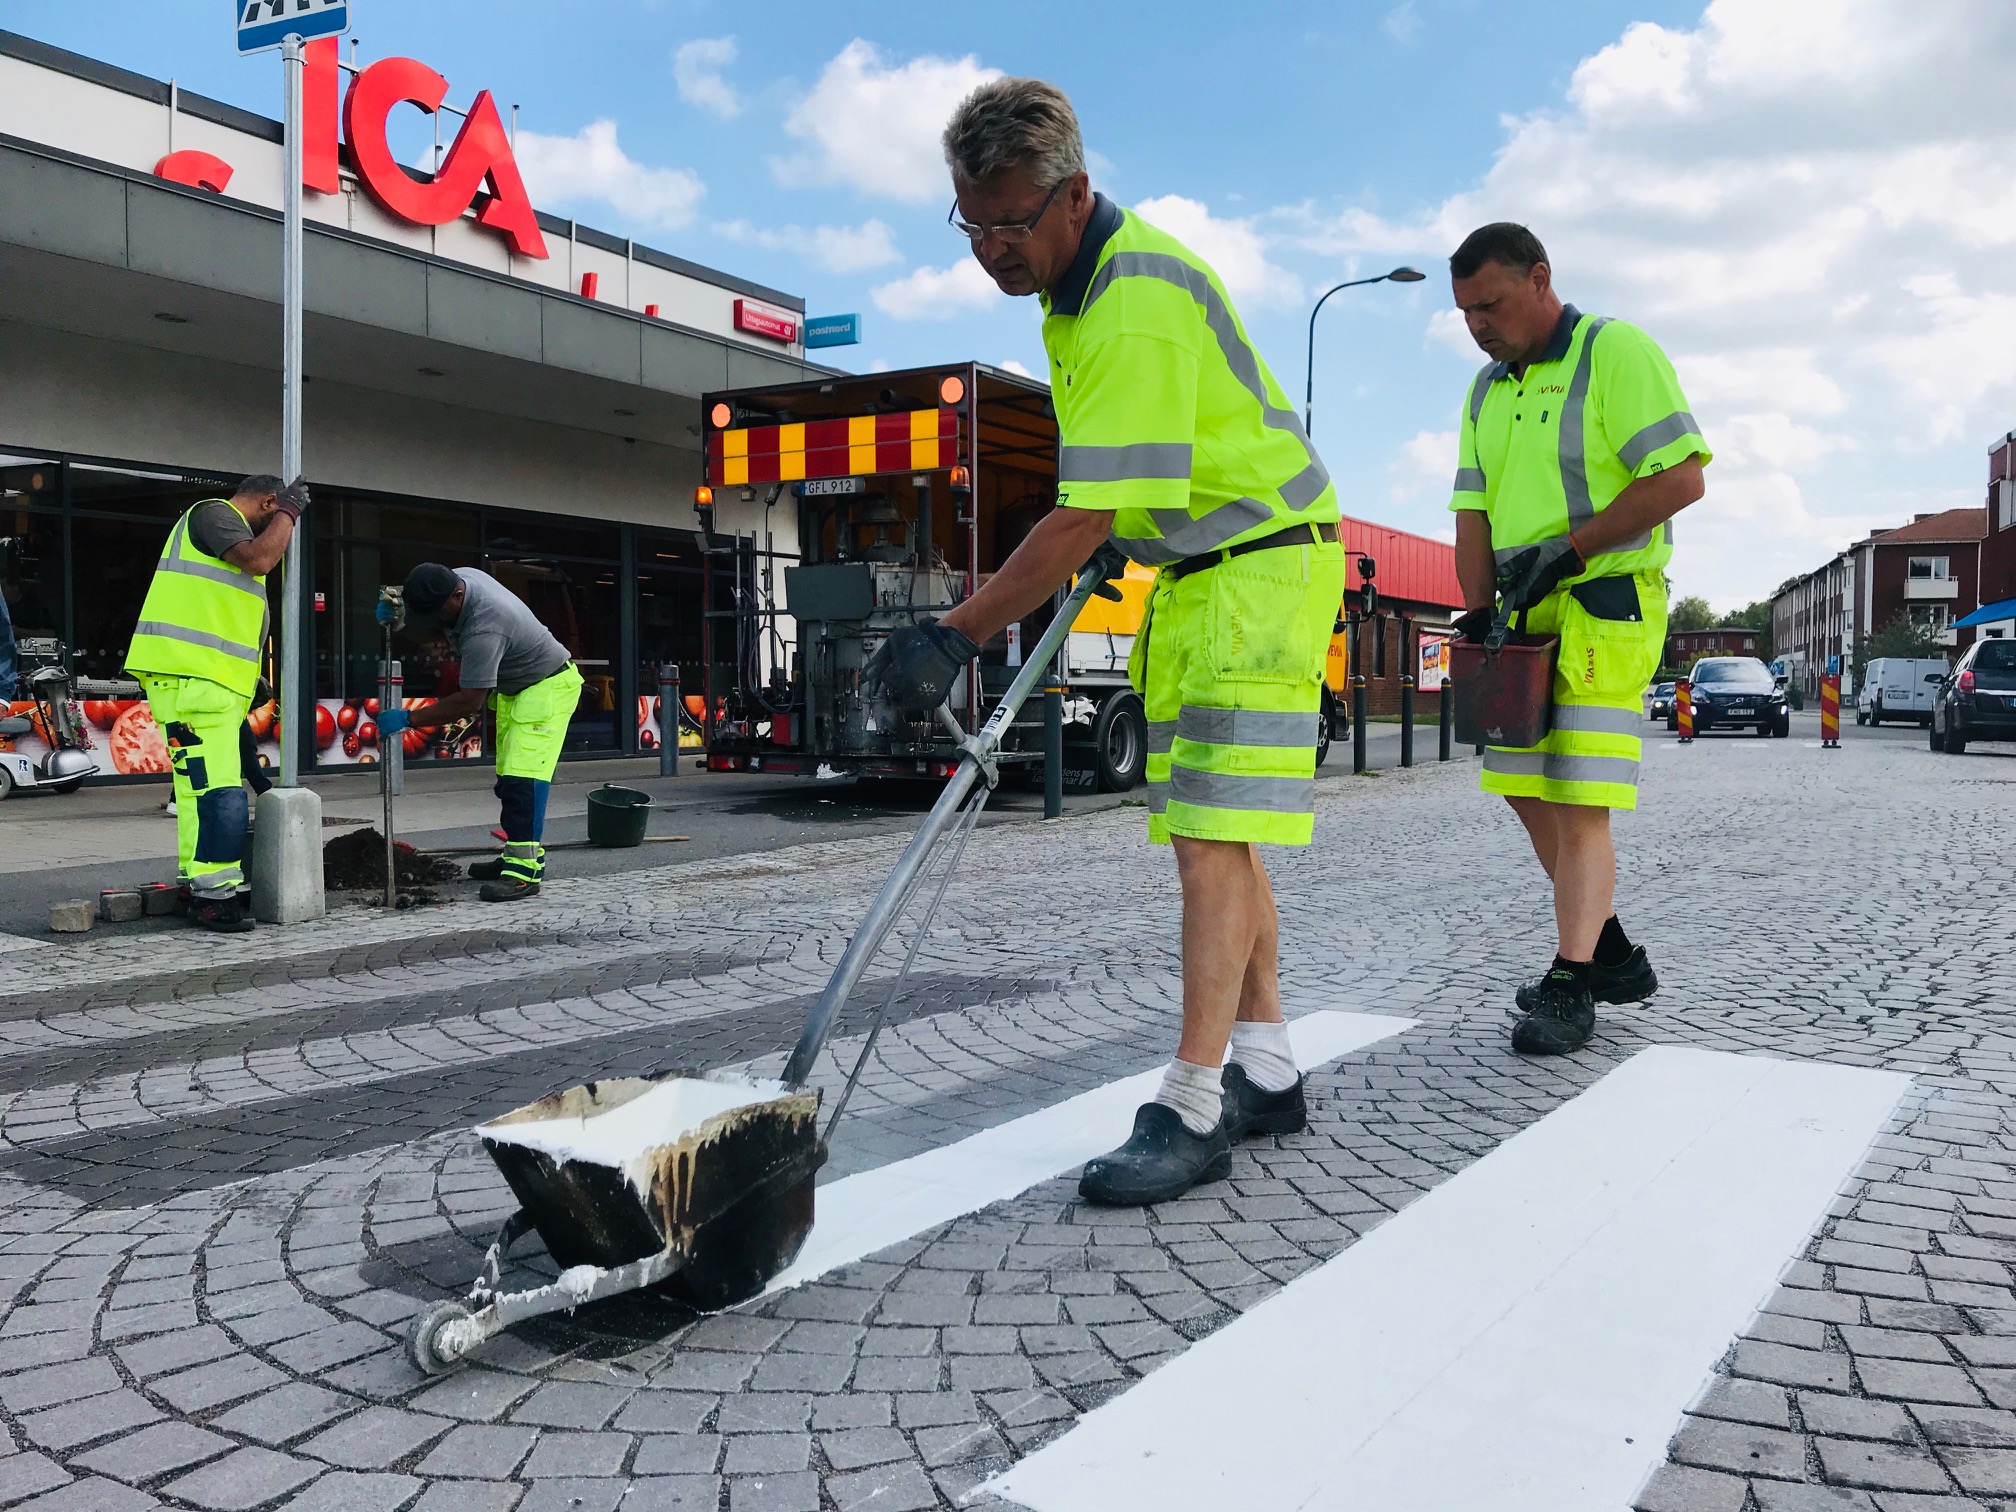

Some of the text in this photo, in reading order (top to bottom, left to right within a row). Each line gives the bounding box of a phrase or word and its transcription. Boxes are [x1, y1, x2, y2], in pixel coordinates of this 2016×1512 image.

[302, 35, 550, 260] ICA
[808, 322, 851, 338] postnord
[808, 480, 852, 494] GFL 912
[1231, 606, 1243, 656] SVEVIA
[1327, 644, 1343, 657] VEVIA
